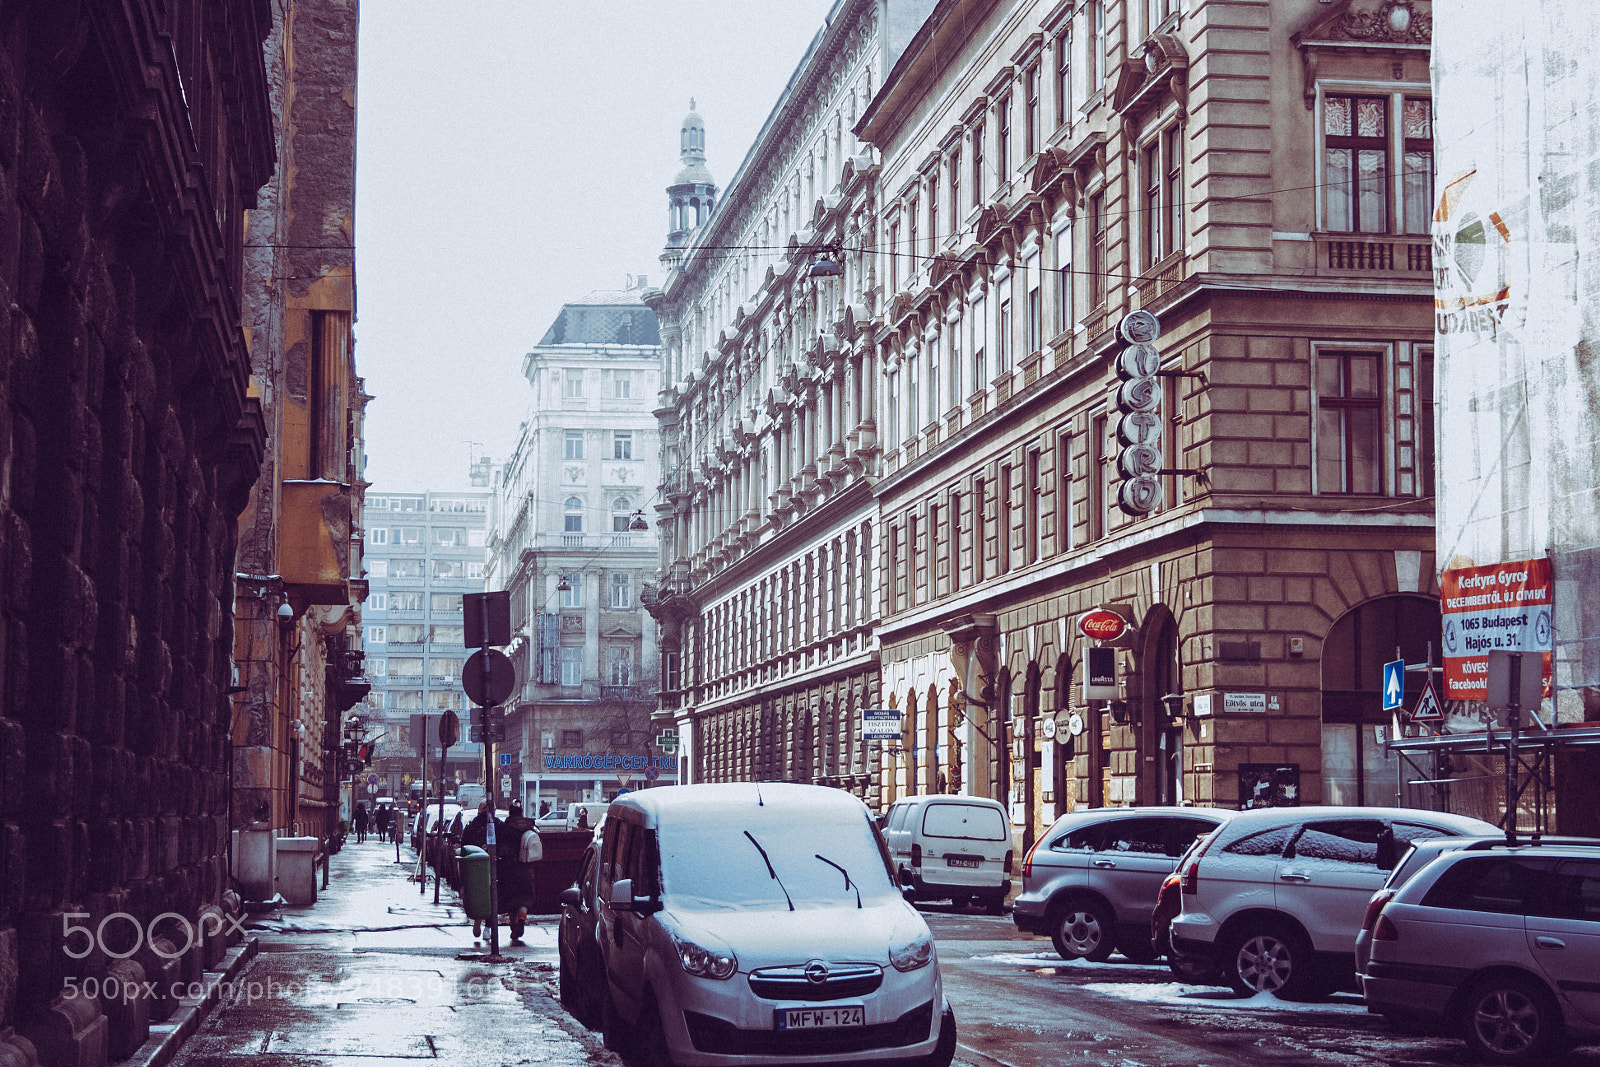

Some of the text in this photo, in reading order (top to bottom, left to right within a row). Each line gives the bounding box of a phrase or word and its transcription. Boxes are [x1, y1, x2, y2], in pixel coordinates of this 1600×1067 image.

[1458, 570, 1528, 590] Kerkyra Gyros
[1084, 618, 1119, 632] Coca-Cola
[1460, 617, 1480, 631] 1065
[1482, 614, 1528, 630] Budapest
[1465, 635, 1491, 652] Hajós
[1494, 636, 1504, 647] u.
[1506, 633, 1521, 646] 31.
[544, 752, 678, 769] VARRÓGÉPCENTRU
[789, 1009, 861, 1027] MFW-124
